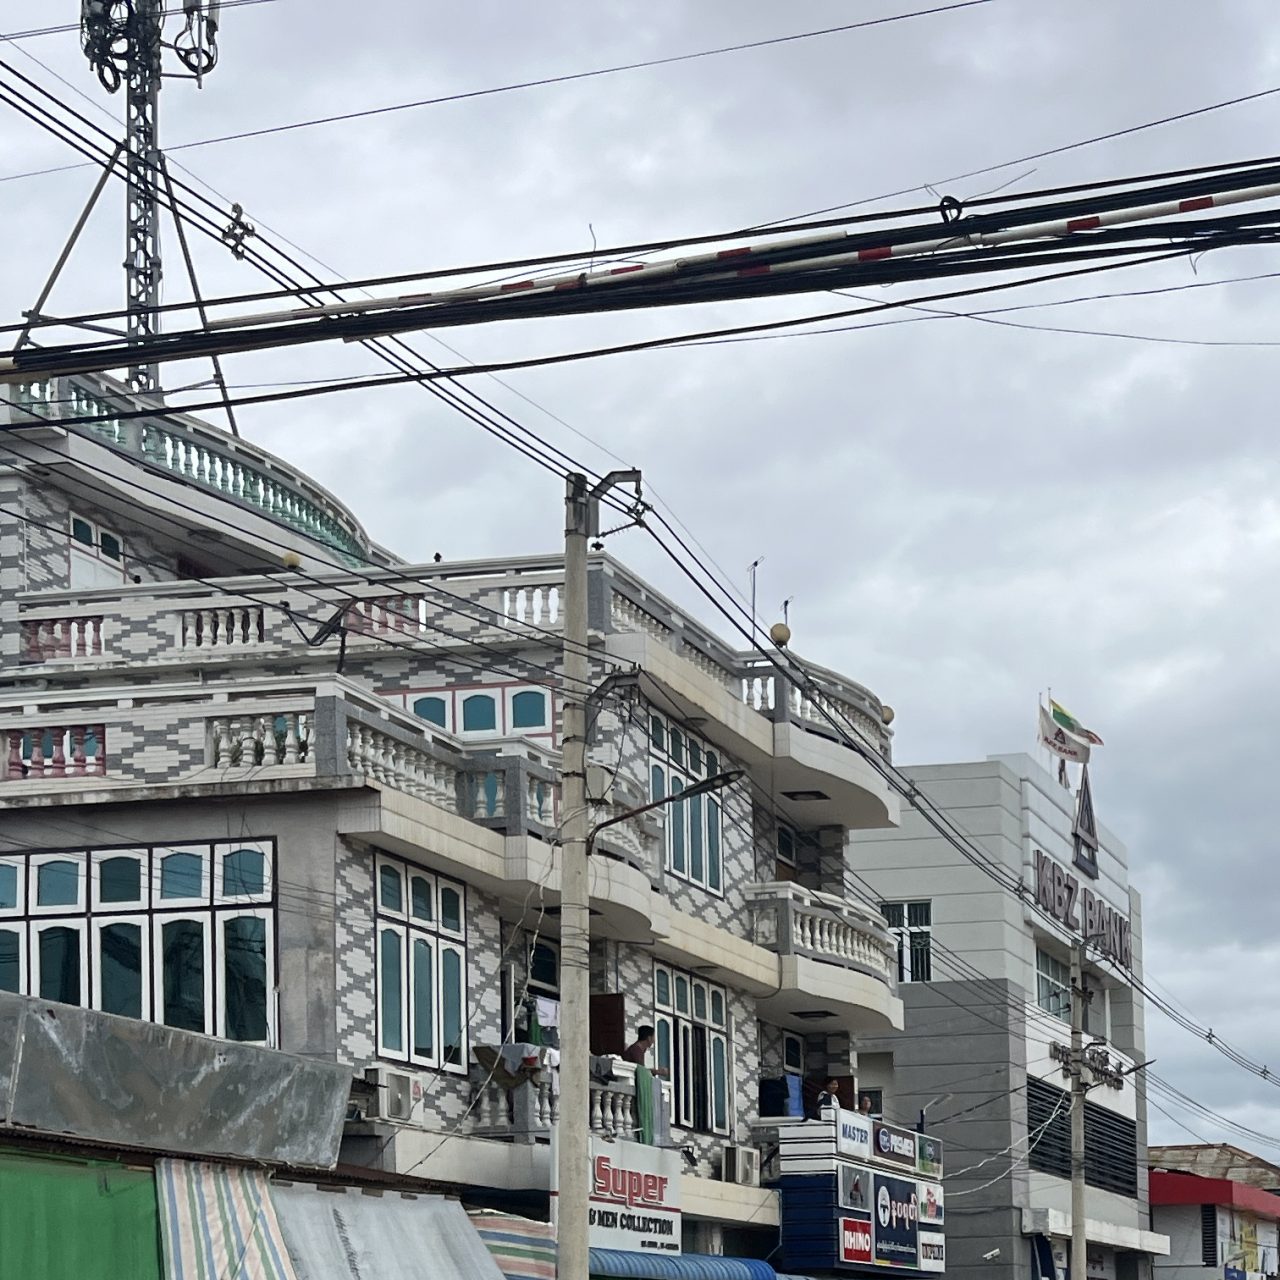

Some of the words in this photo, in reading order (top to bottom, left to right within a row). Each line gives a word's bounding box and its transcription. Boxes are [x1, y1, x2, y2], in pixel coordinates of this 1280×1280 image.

[1033, 849, 1080, 932] KBZ
[1081, 888, 1131, 970] BANK
[842, 1123, 869, 1145] MASTER
[594, 1155, 668, 1207] Super
[597, 1209, 619, 1229] MEN
[620, 1212, 674, 1236] COLLECTION
[844, 1230, 871, 1252] RHINO
